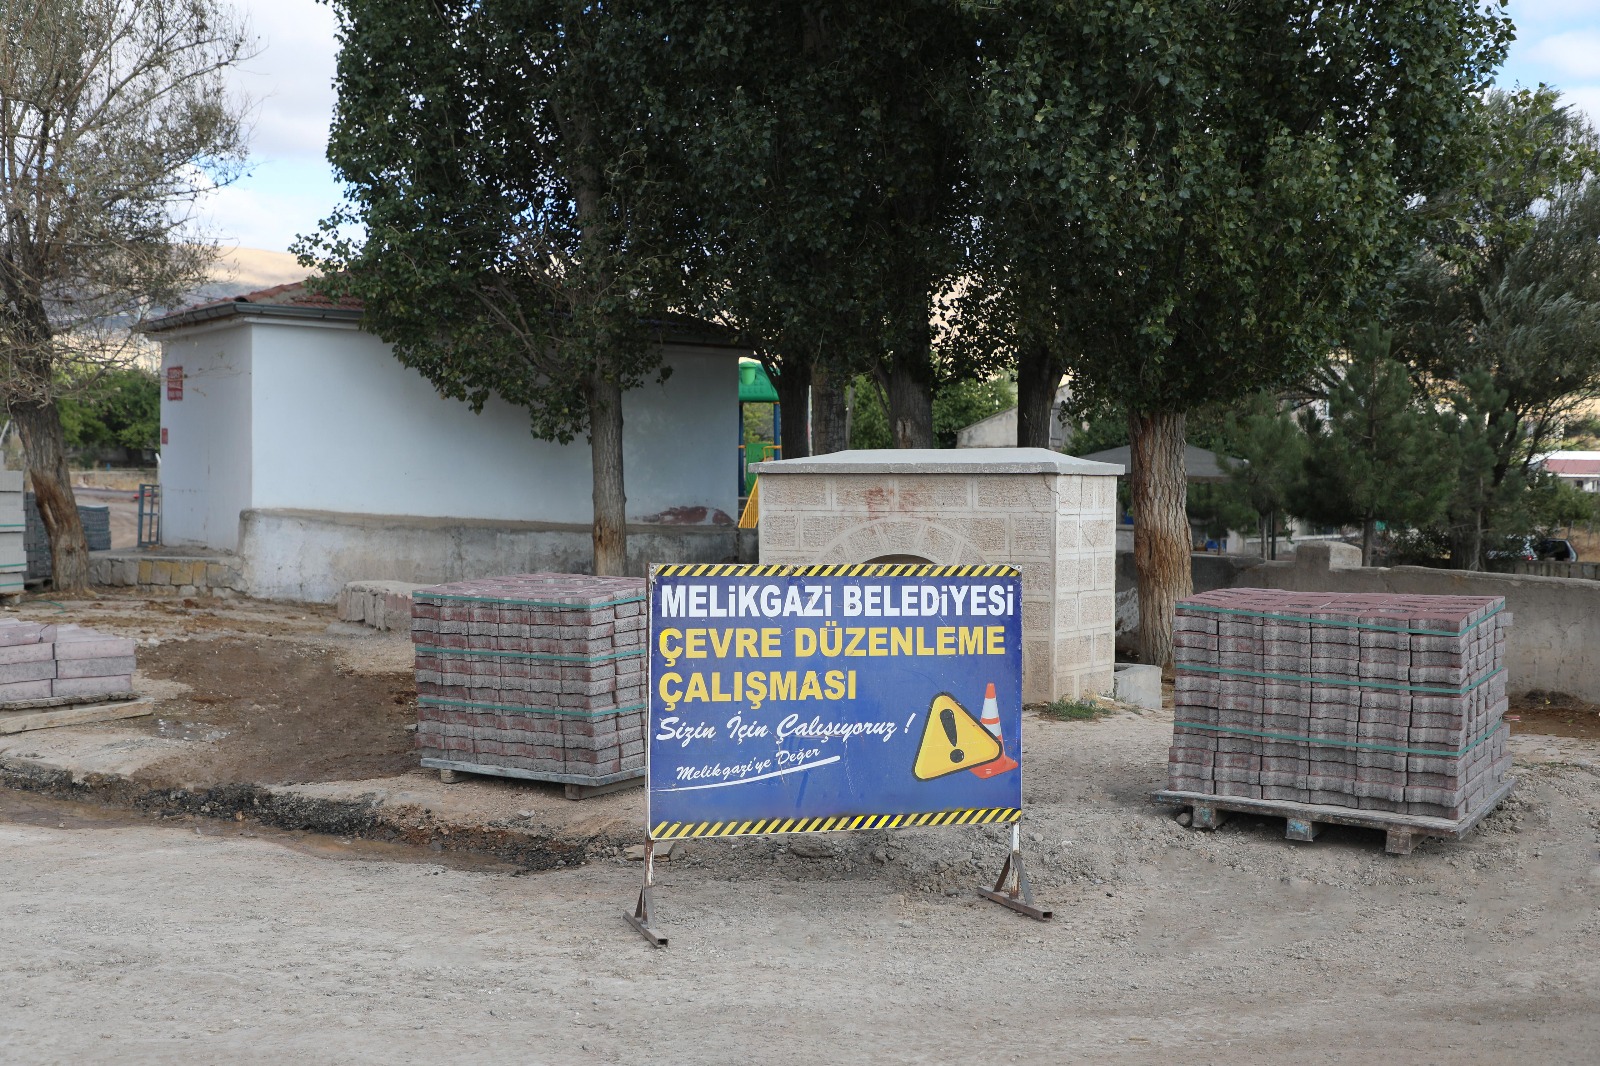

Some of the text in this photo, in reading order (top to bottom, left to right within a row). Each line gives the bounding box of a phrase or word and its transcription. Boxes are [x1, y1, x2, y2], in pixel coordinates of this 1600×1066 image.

[659, 621, 1006, 666] ÇEVRE DÜZENLEME
[658, 670, 857, 711] ÇALIŞMASI
[655, 716, 716, 747] Sizin
[726, 711, 769, 746] İçin
[776, 747, 821, 766] Değer
